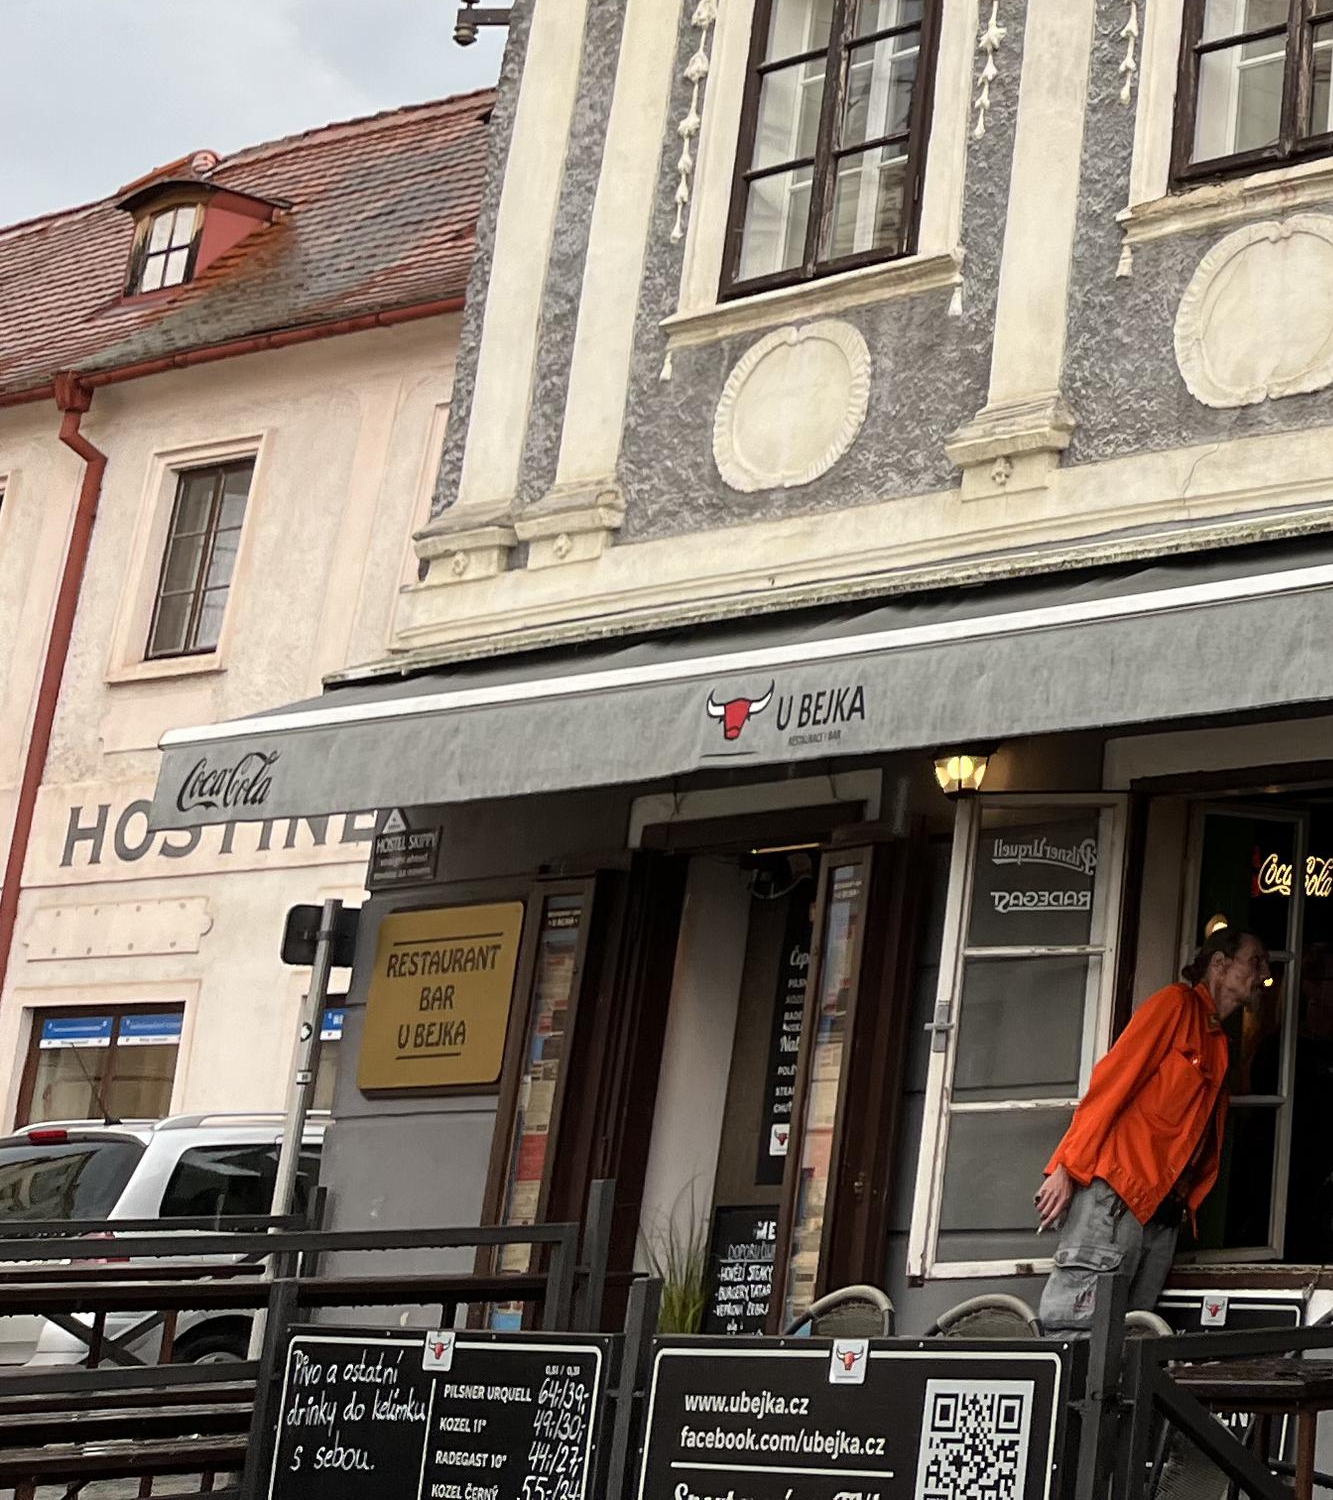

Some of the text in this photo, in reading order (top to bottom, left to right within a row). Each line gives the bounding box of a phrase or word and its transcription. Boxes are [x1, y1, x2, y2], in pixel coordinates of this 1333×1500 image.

[776, 685, 865, 730] U BEJKA
[176, 750, 280, 812] Coca-Cola
[386, 944, 502, 978] RESTAURANT
[419, 985, 455, 1011] BAR
[398, 1020, 466, 1049] U BEJKA
[293, 1350, 404, 1385] Pivo a ostatní
[444, 1385, 484, 1400] PILSNER
[487, 1386, 532, 1403] URQUELL
[684, 1390, 809, 1419] www.ubejka.cz
[286, 1387, 426, 1437] drinky do kelímku
[440, 1417, 471, 1433] KOZEL
[680, 1426, 885, 1459] facebook.com/ubejka.cz
[290, 1447, 303, 1471] s
[435, 1451, 488, 1467] RADEGAST
[431, 1484, 463, 1499] KOZEL
[464, 1481, 499, 1500] ČERNÝ
